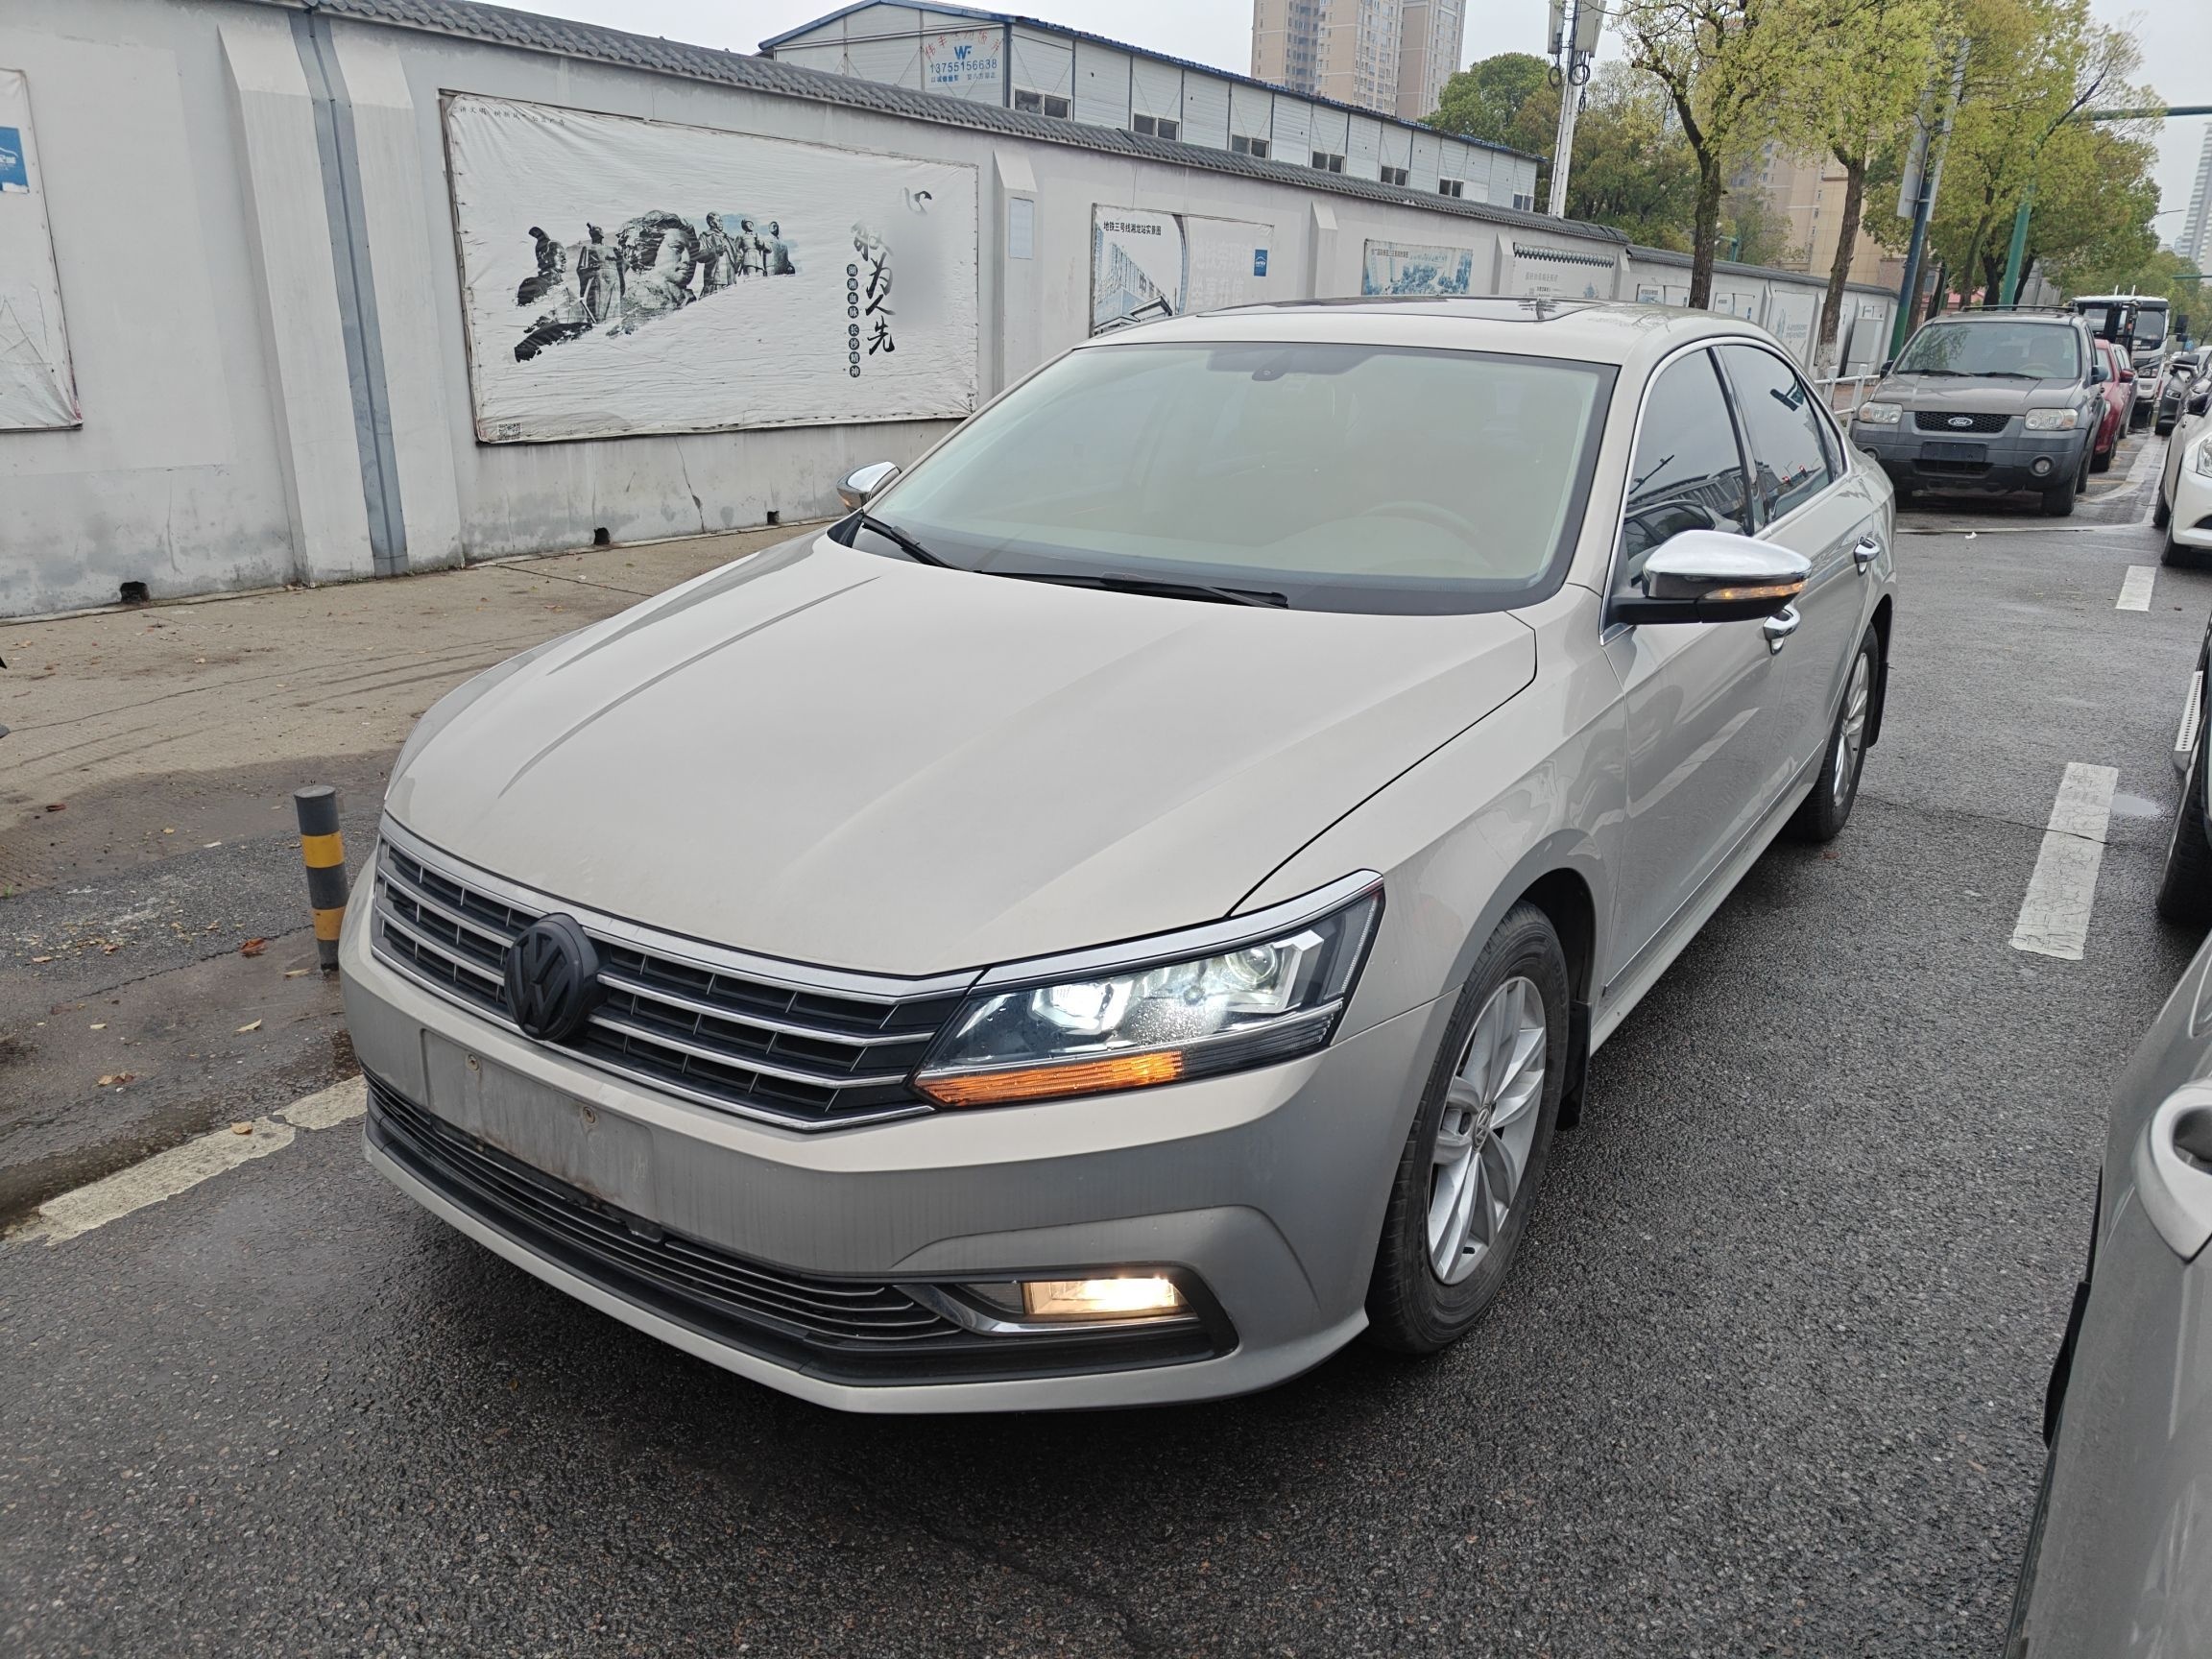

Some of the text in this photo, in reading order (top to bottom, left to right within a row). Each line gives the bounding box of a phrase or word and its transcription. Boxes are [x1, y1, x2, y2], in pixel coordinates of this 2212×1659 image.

[930, 59, 998, 74] 13755156638
[848, 324, 861, 378] 长沙精神
